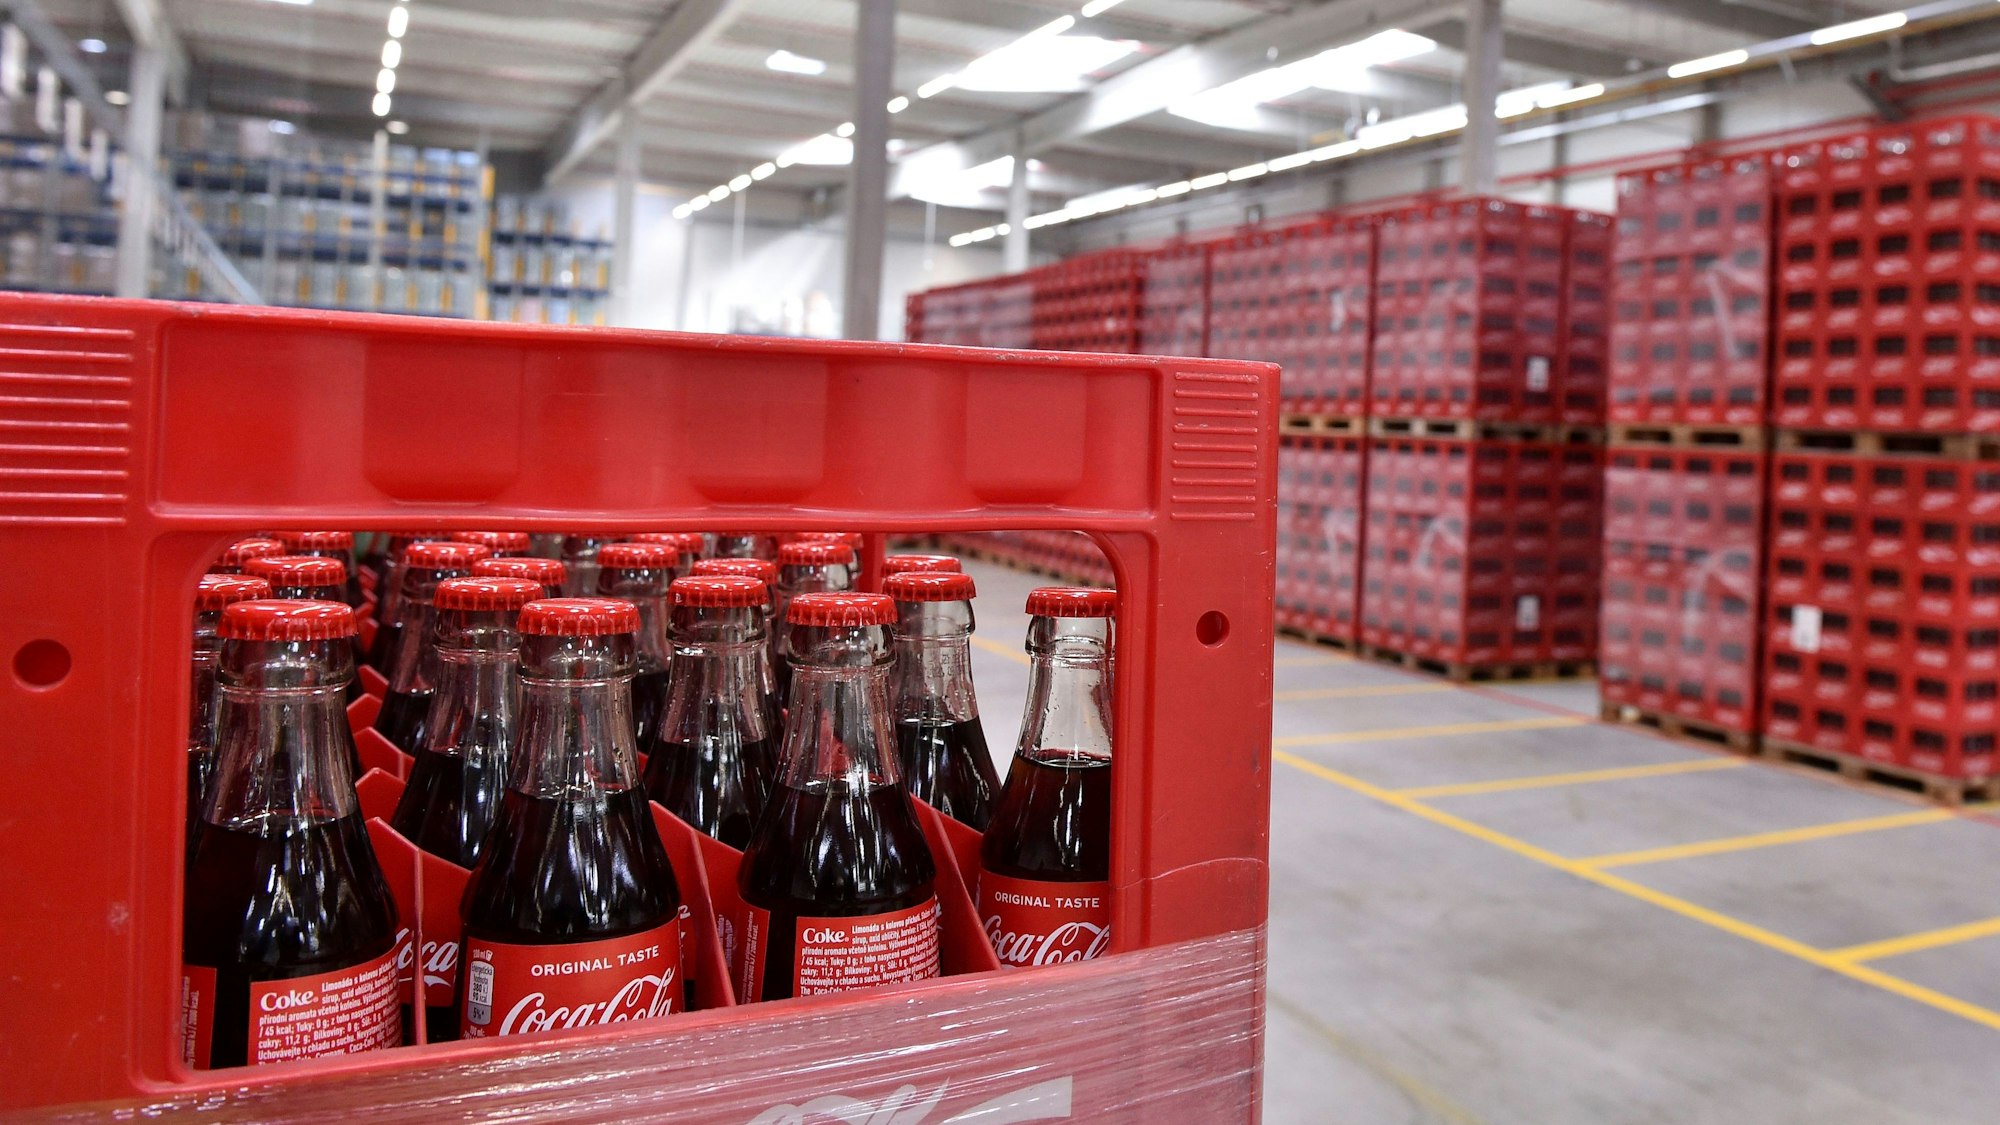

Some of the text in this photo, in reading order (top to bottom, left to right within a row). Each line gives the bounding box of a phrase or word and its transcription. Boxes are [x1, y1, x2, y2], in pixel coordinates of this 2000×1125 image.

[994, 891, 1100, 908] ORIGINAL TASTE
[852, 924, 880, 934] Limonáda
[886, 919, 905, 929] kolovou
[803, 928, 845, 944] Coke
[852, 937, 868, 945] sirup,
[869, 934, 881, 942] oxid
[802, 947, 824, 956] přírodní
[824, 947, 848, 956] aromata
[848, 946, 867, 954] včetně
[868, 944, 888, 953] kofeinu.
[531, 945, 660, 977] ORIGINAL TASTE
[806, 957, 813, 965] 45
[814, 957, 829, 967] kcal;
[830, 957, 846, 967] Tuky:
[847, 956, 851, 965] 0
[877, 951, 901, 962] nasycené
[801, 968, 819, 978] cukry:
[821, 968, 833, 977] 11,2
[844, 966, 872, 976] Bílkoviny:
[874, 964, 879, 972] 0
[887, 961, 897, 970] Sůl:
[899, 959, 903, 967] 0
[322, 977, 353, 992] Limonáda
[359, 969, 378, 982] kolovou
[473, 983, 483, 993] 380
[800, 977, 834, 987] Uchovávejte
[839, 977, 859, 986] chladu
[864, 974, 881, 983] suchu.
[342, 989, 354, 1000] oxid
[801, 987, 811, 995] The
[260, 990, 314, 1011] Coke
[260, 1012, 288, 1027] přírodní
[288, 1009, 317, 1022] aromata
[318, 1005, 339, 1017] včetně
[259, 1027, 264, 1039] /
[265, 1026, 275, 1037] 45
[276, 1024, 295, 1036] kcal;
[296, 1022, 315, 1033] Tuky:
[316, 1019, 321, 1028] 0
[323, 1019, 330, 1030] g;
[331, 1018, 335, 1026] z
[336, 1013, 350, 1024] toho
[258, 1039, 282, 1050] cukry:
[285, 1034, 301, 1046] 11,2
[304, 1035, 311, 1044] g;
[314, 1028, 345, 1041] Bílkoviny:
[347, 1022, 352, 1032] 0
[258, 1046, 302, 1060] Uchovávejte
[302, 1046, 307, 1054] v
[308, 1040, 330, 1053] chladu
[336, 1034, 356, 1047] suchu.
